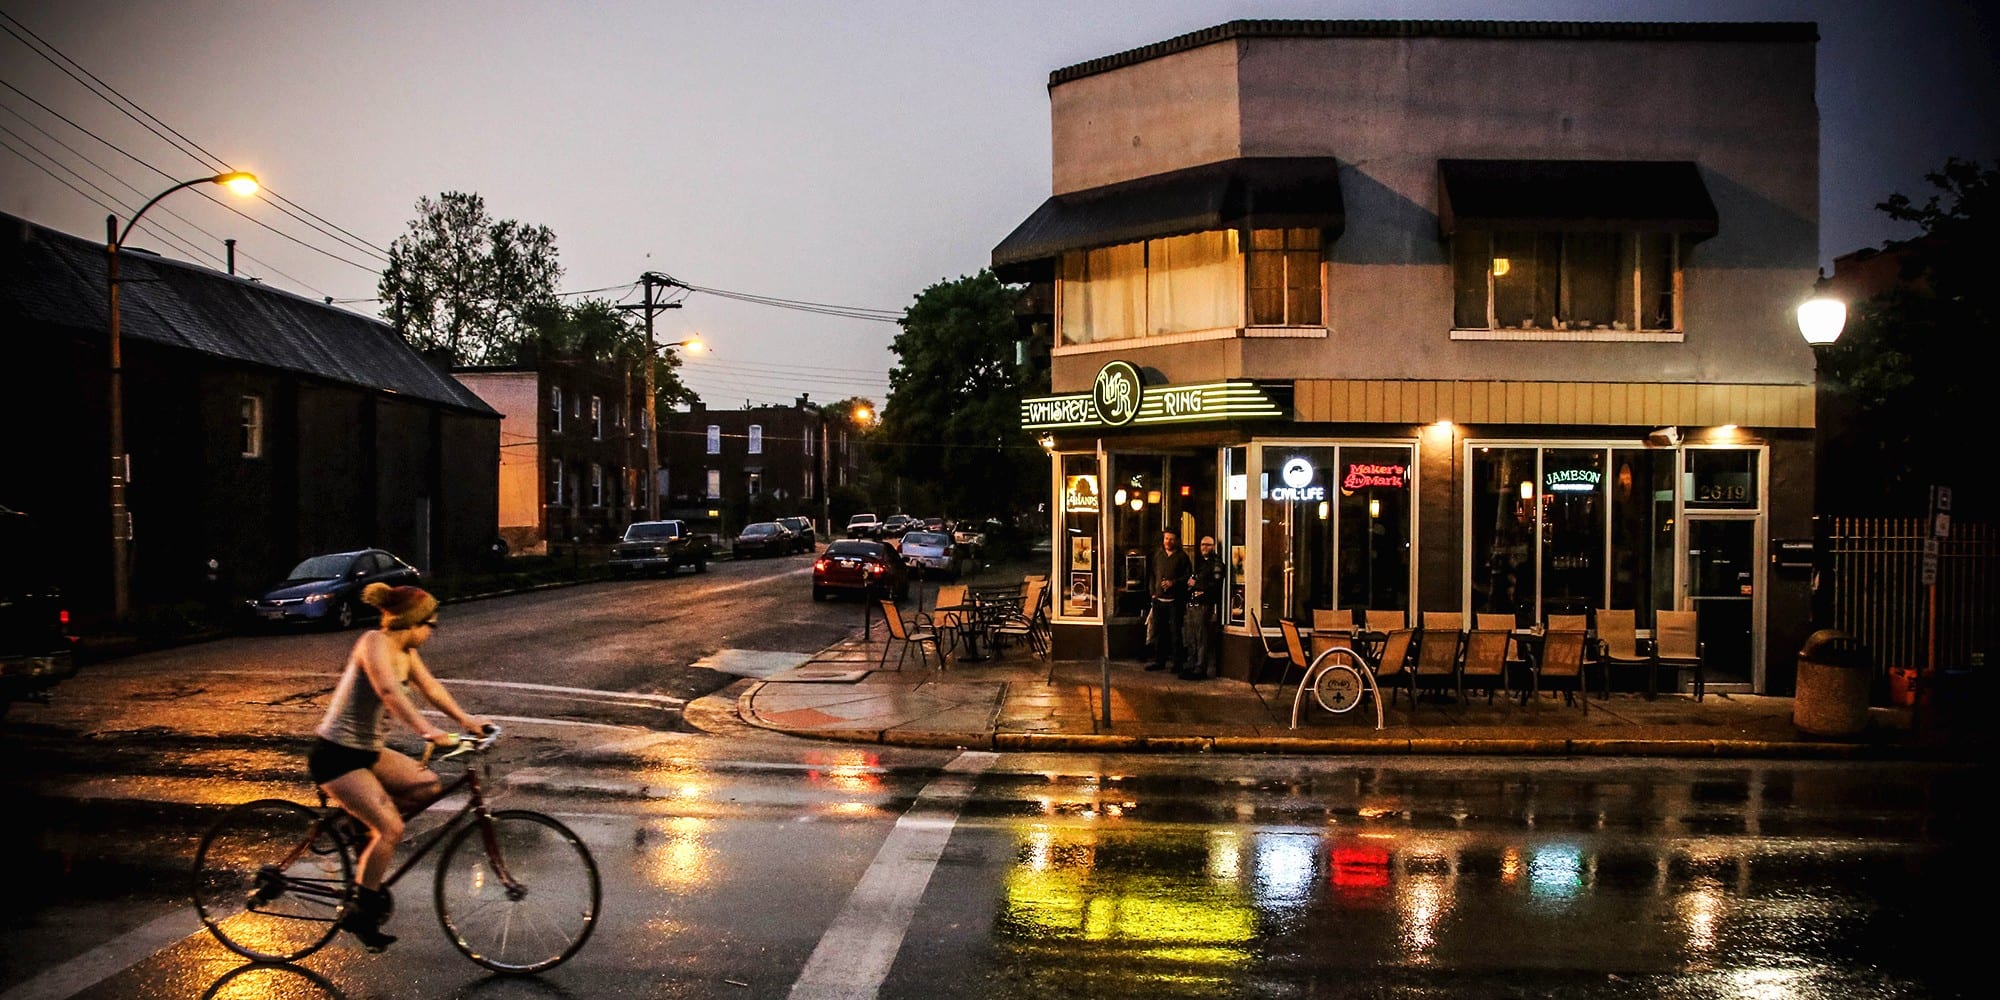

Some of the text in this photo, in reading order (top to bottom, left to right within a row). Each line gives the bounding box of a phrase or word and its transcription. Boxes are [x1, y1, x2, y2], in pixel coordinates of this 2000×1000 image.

[1029, 389, 1202, 423] WHISKEY RING
[1350, 464, 1404, 474] Maker's
[1365, 476, 1402, 487] Mark
[1545, 469, 1601, 486] JAMESON
